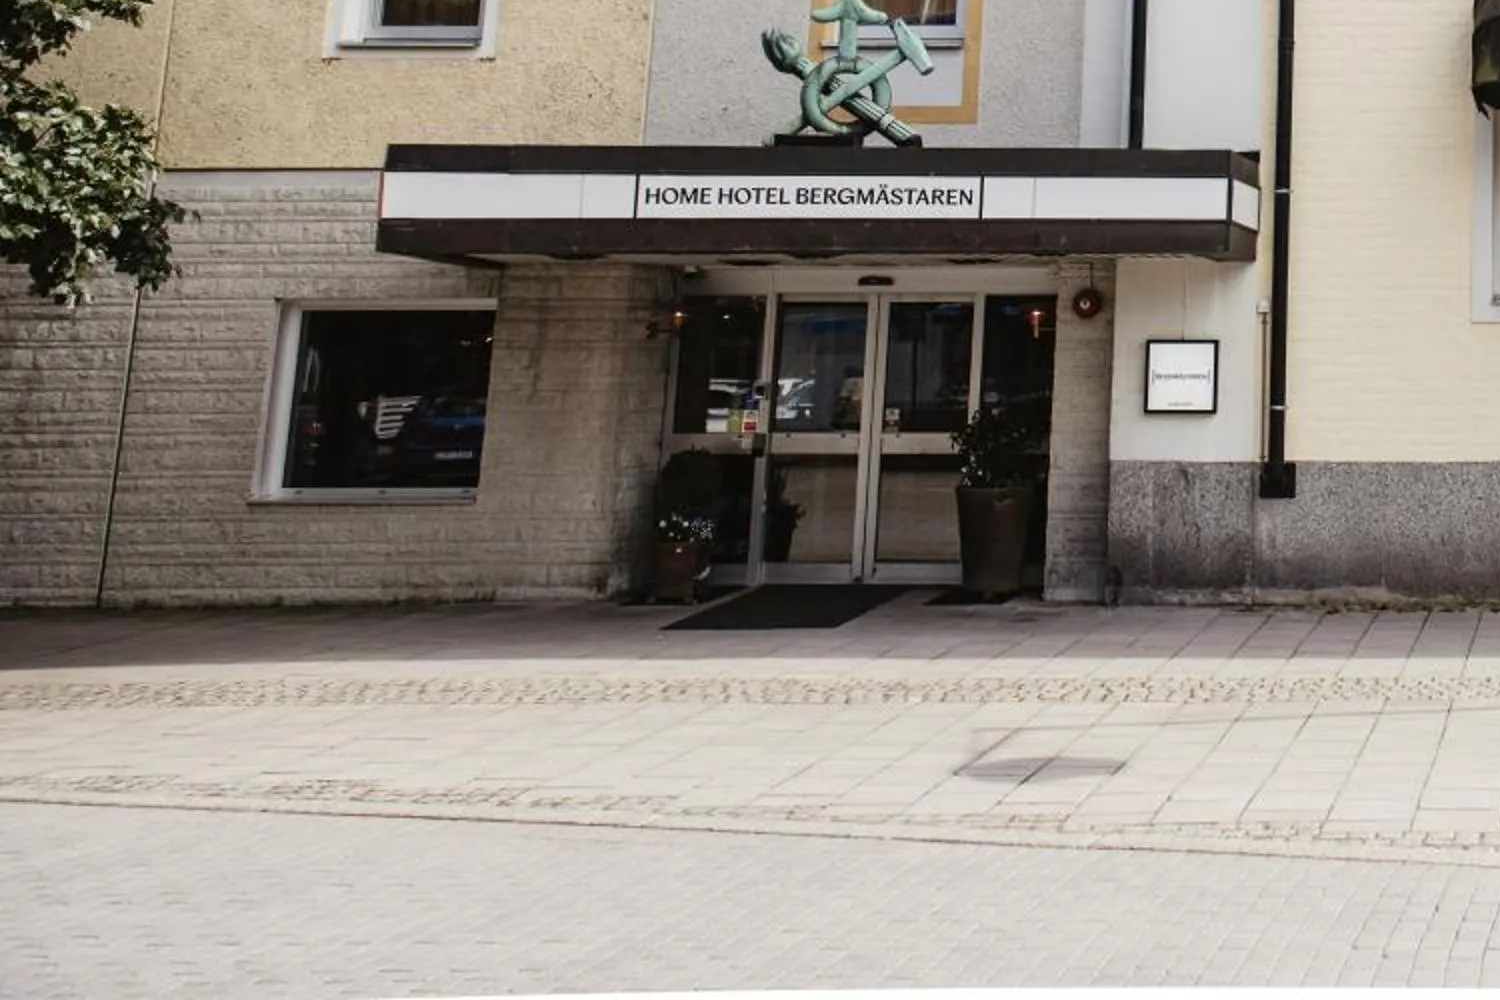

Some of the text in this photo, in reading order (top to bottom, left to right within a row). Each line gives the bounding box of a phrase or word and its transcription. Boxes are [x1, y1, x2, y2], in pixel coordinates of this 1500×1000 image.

[645, 184, 974, 205] HOME HOTEL BERGMÄSTAREN
